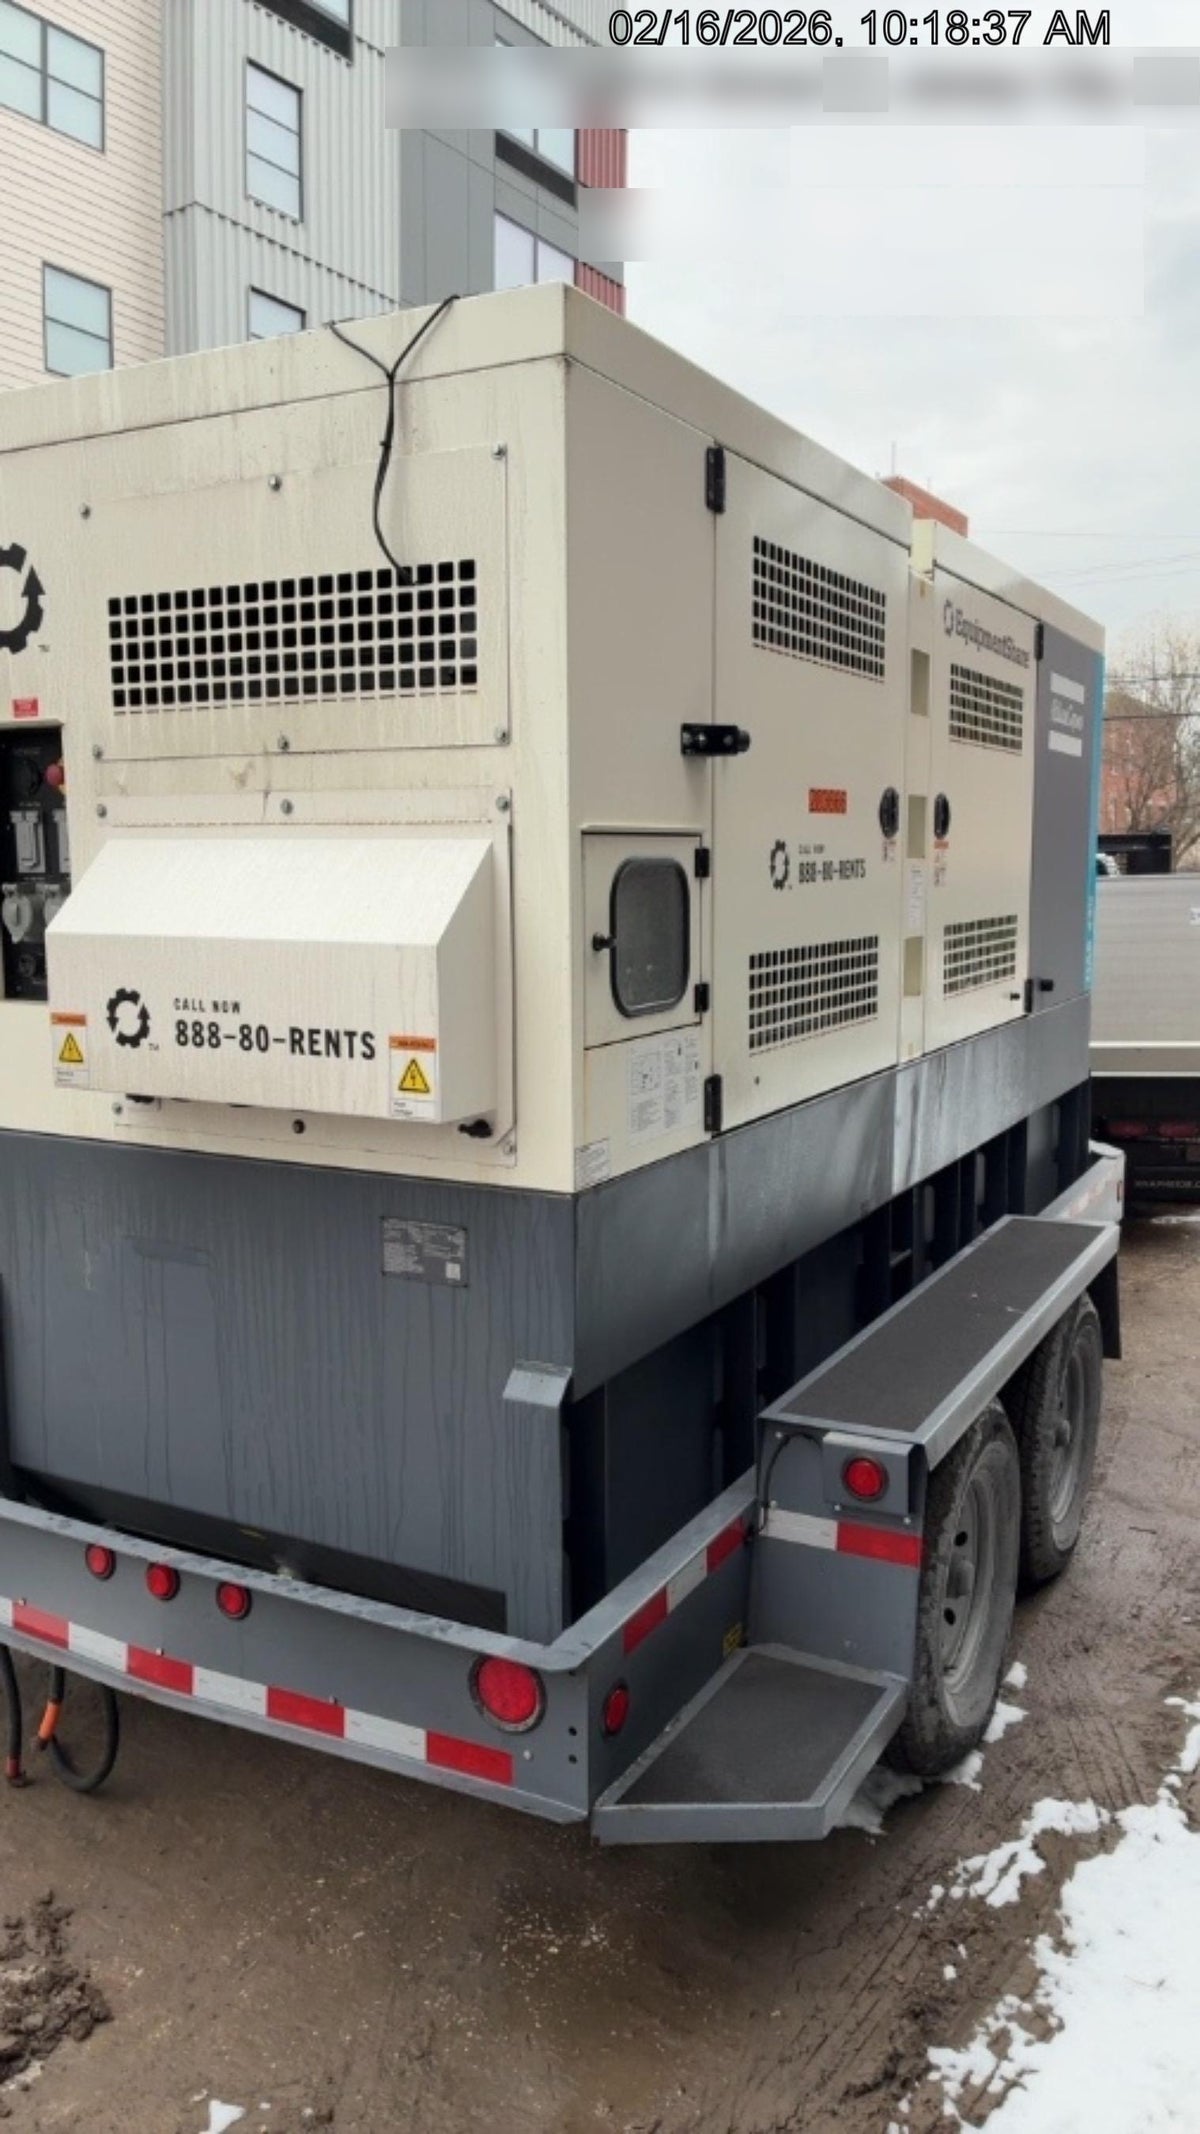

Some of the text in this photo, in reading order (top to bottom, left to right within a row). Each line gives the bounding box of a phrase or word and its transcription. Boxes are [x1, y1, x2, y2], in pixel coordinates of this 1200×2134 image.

[173, 998, 241, 1014] CALL NOW
[175, 1019, 376, 1060] 888-80-RENTS
